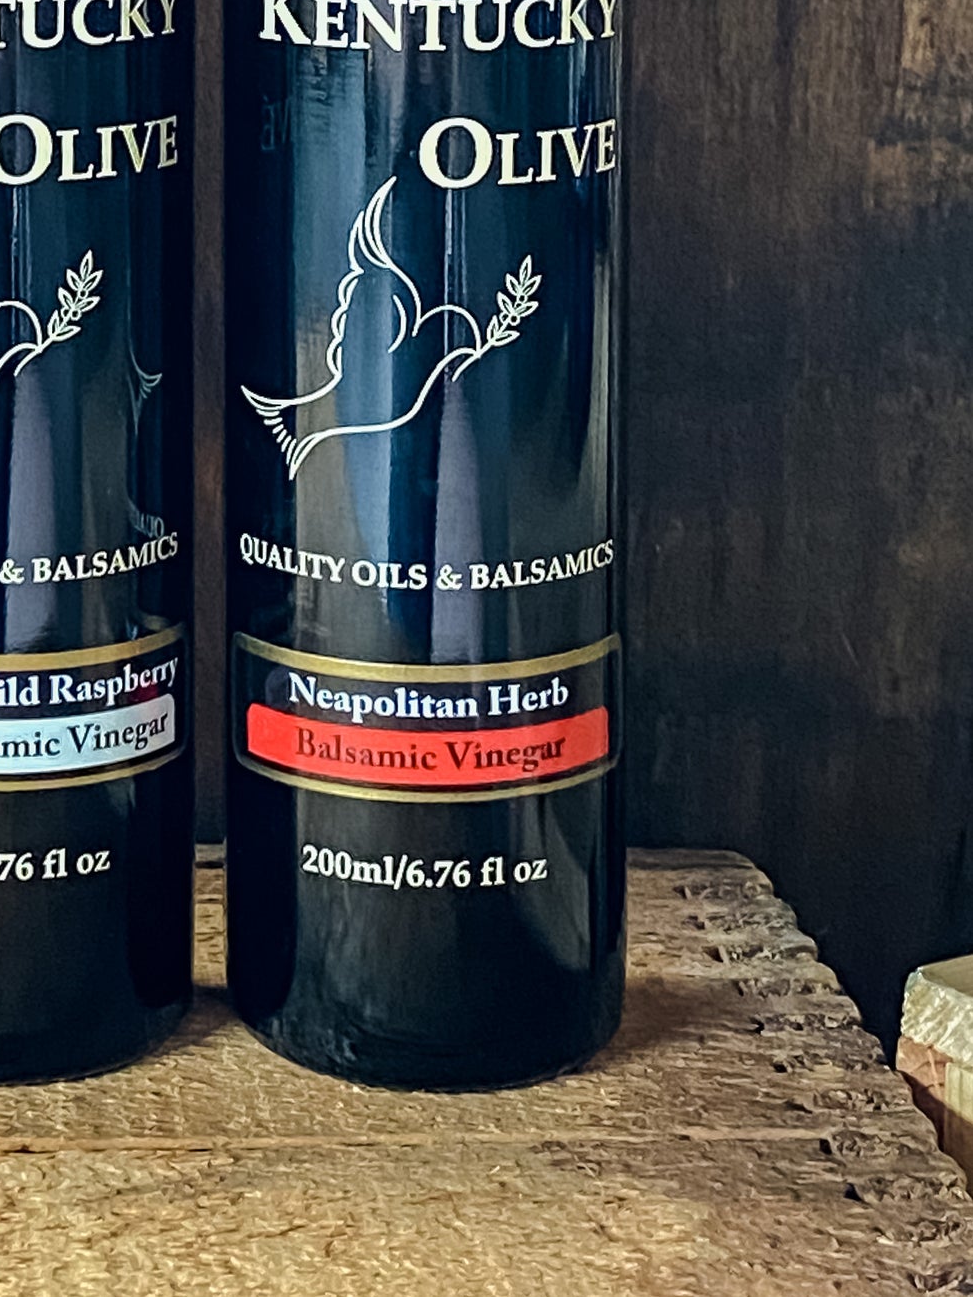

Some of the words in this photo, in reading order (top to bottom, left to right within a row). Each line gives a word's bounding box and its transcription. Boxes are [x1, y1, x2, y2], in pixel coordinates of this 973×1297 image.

[419, 117, 616, 189] OLIVE
[32, 531, 179, 584] BALSAMICS
[240, 533, 345, 582] QUALITY
[351, 559, 427, 590] OILS
[435, 565, 462, 590] &
[469, 539, 614, 590] BALSAMICS
[49, 656, 179, 708] Raspberry
[288, 672, 478, 723] Neapolitan
[487, 677, 569, 715] Herb
[67, 712, 169, 750] Vinegar
[295, 726, 437, 770] Balsamic
[444, 735, 566, 772] Vinegar
[42, 849, 68, 879] fl
[75, 849, 111, 874] oz
[301, 844, 472, 890] 200ml/6.76
[479, 858, 504, 887] fl
[513, 857, 548, 883] oz
